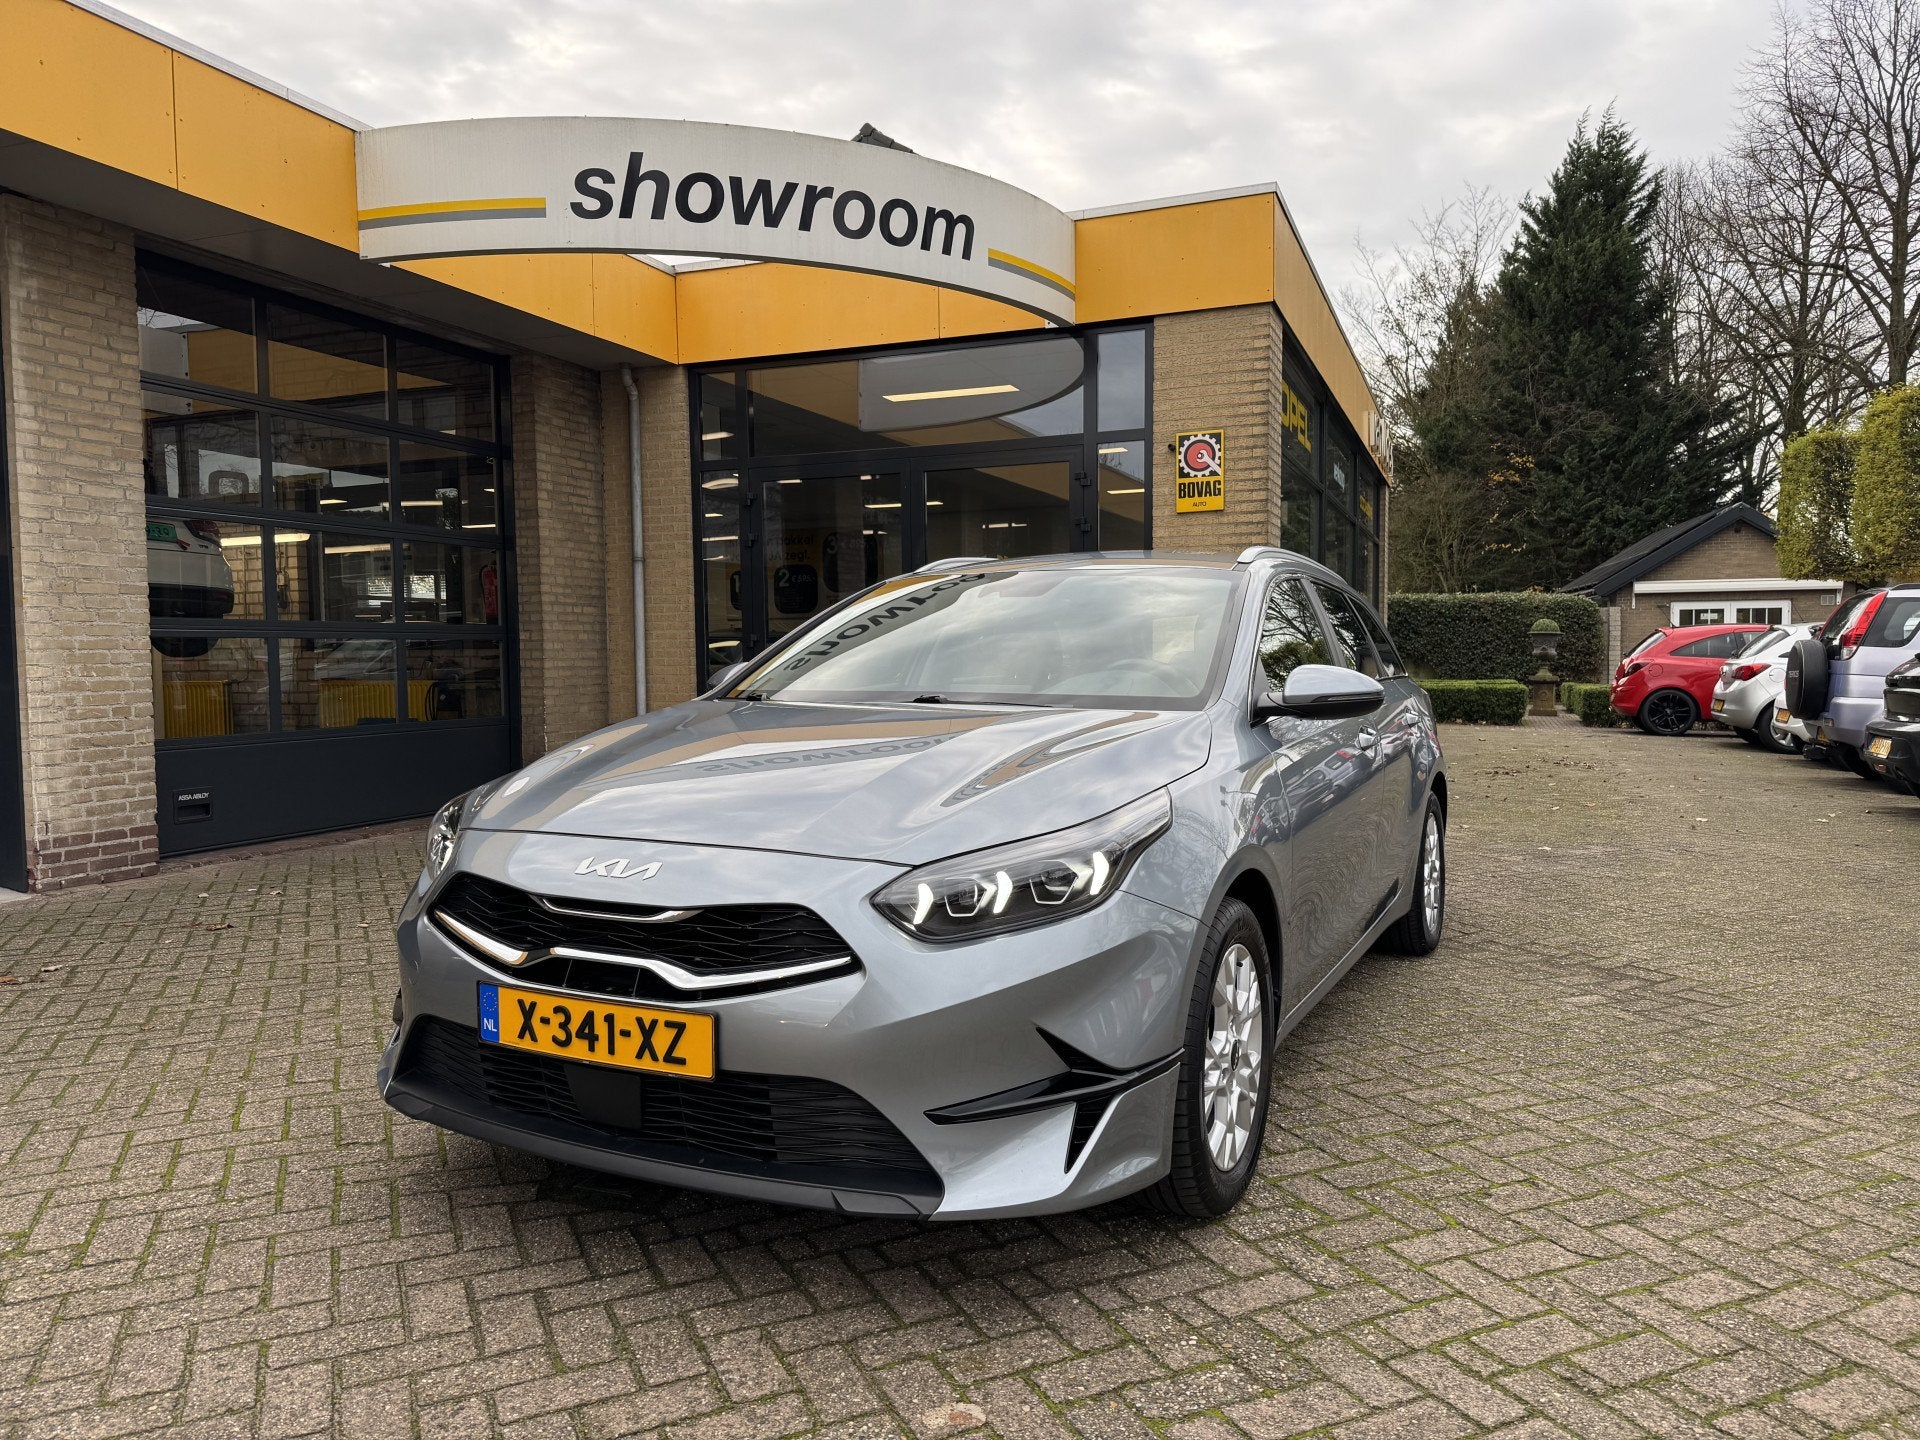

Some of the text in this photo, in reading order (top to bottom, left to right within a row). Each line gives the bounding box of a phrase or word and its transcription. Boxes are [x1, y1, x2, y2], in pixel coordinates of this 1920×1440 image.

[569, 151, 976, 261] showroom
[1178, 479, 1222, 499] BOVAG
[778, 569, 790, 587] 2
[178, 793, 193, 801] ASSA
[574, 856, 663, 881] KIA
[483, 998, 687, 1066] NL X-341-XZ
